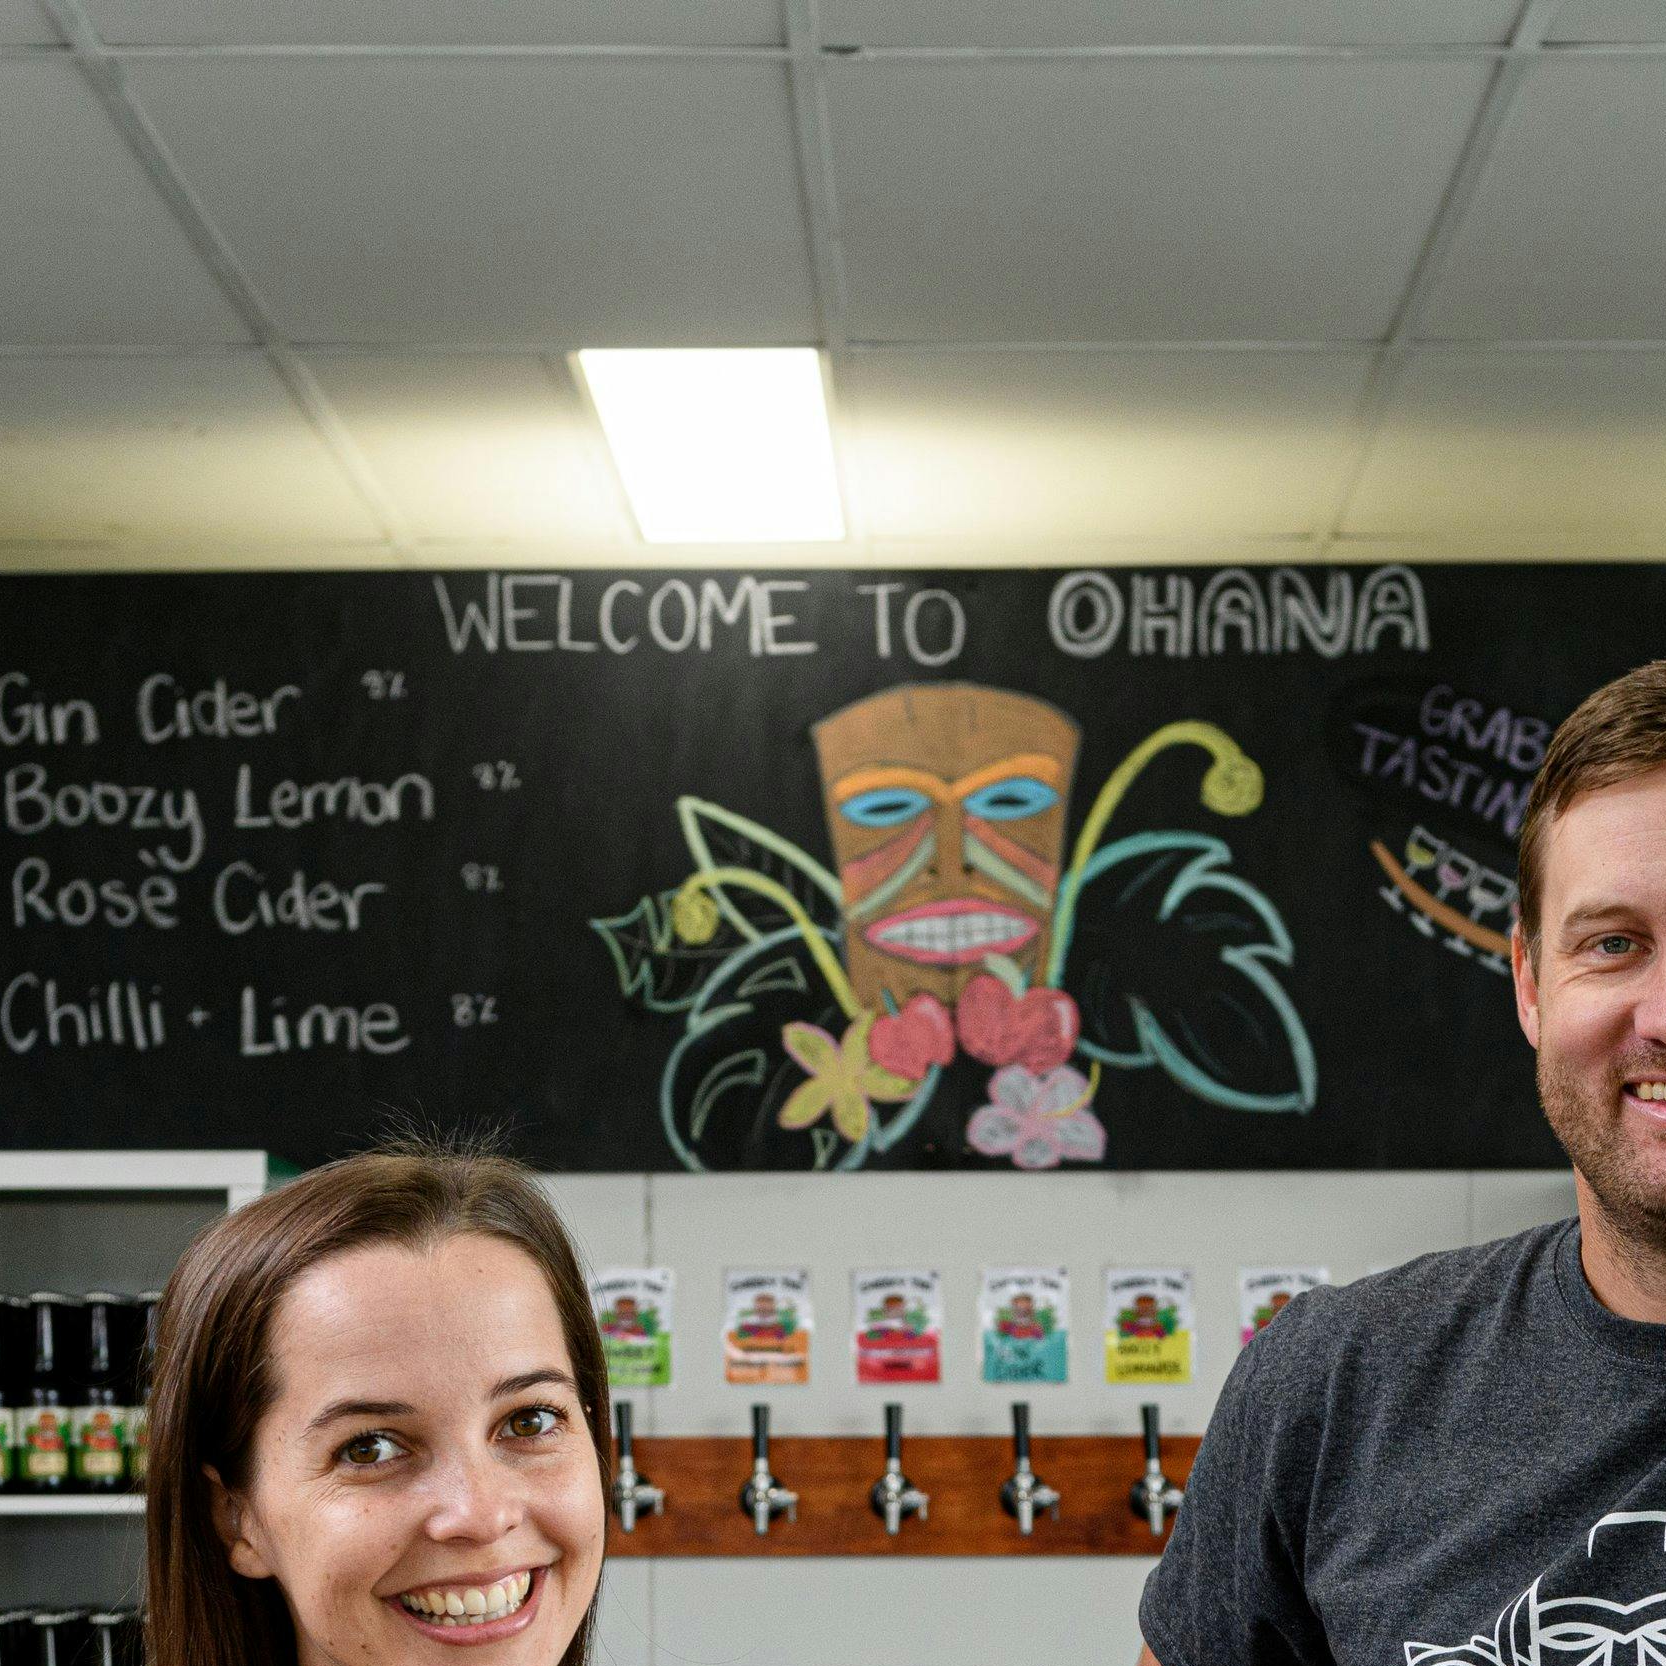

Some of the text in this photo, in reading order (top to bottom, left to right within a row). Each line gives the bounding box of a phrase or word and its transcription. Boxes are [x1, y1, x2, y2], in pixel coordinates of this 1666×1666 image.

[433, 564, 1428, 666] WELCOME TO OHANA
[138, 674, 303, 745] Cider
[4, 764, 205, 872] Boozy
[236, 764, 433, 828] Lemon
[214, 861, 386, 934] Cider
[1, 972, 165, 1053] Chilli
[241, 986, 411, 1057] Lime
